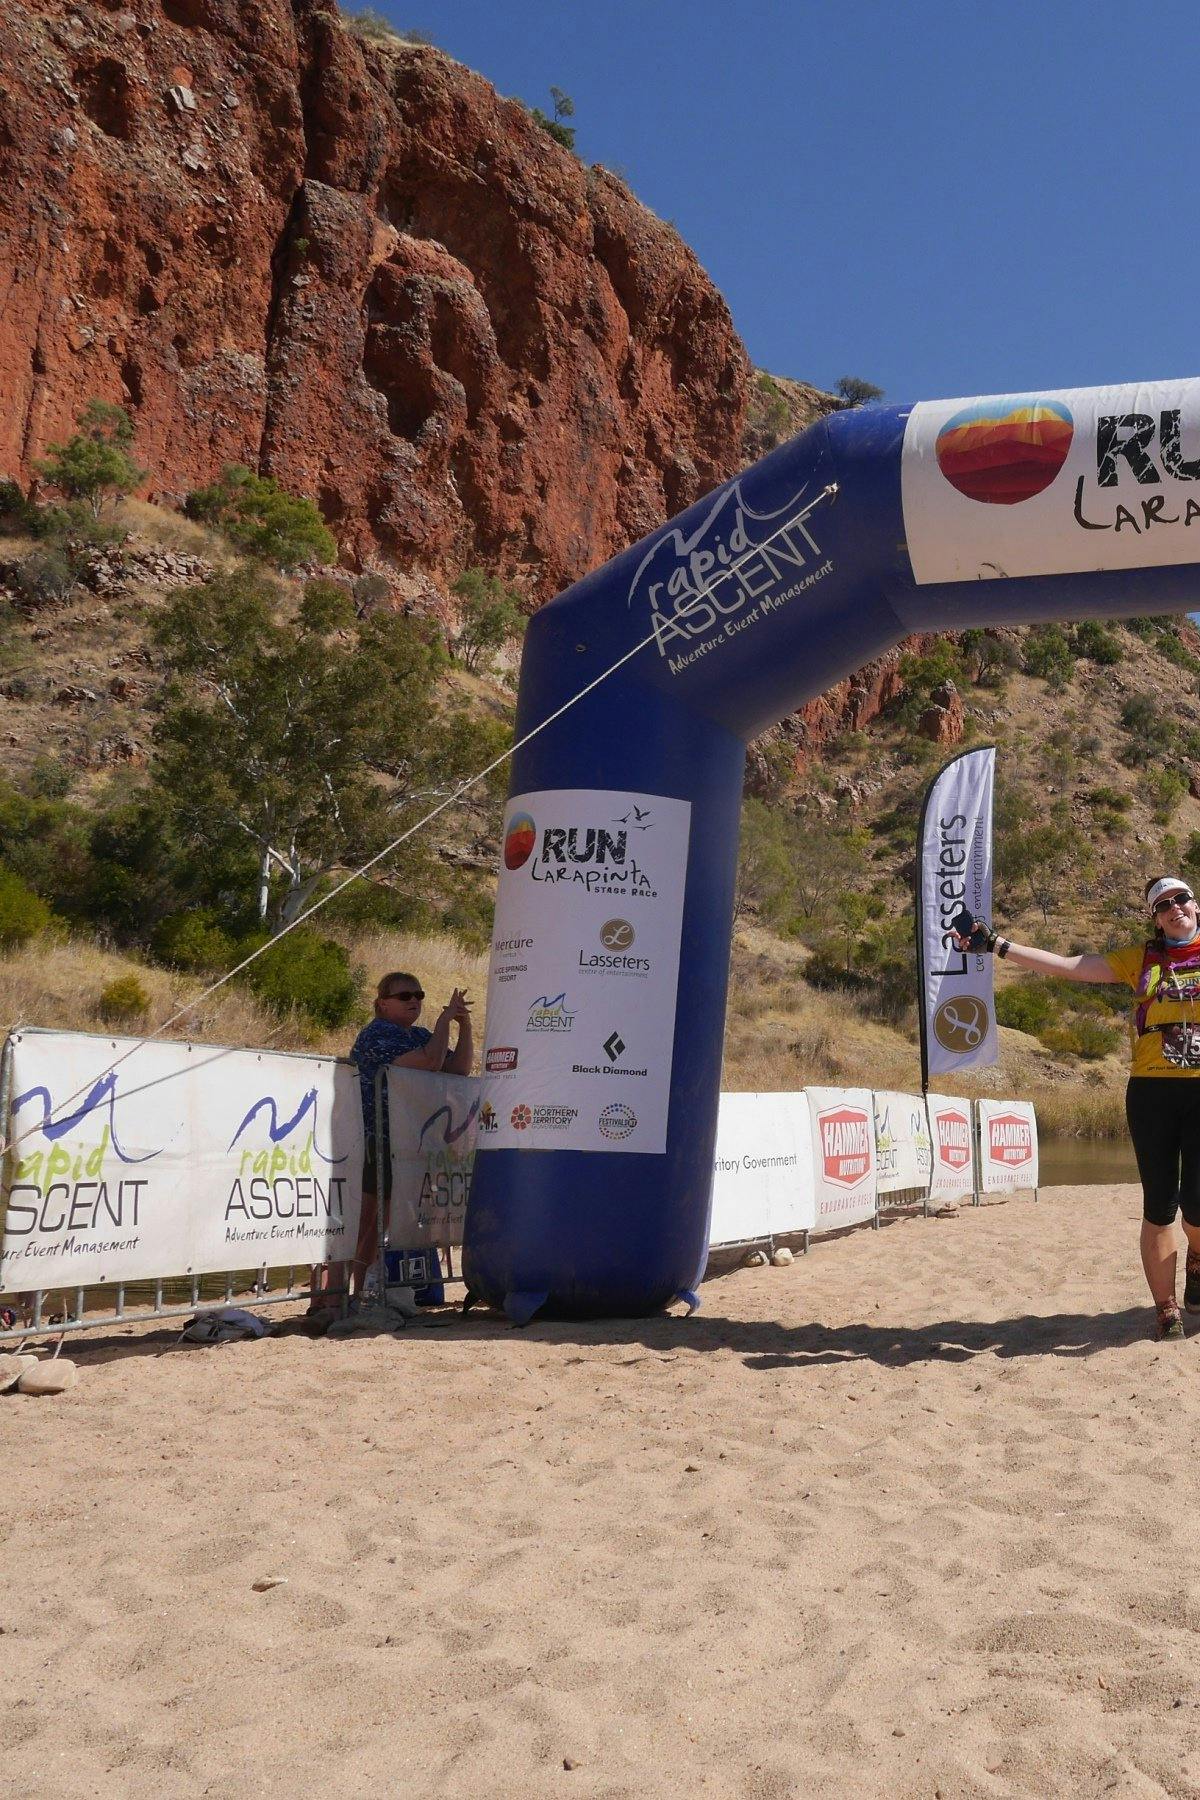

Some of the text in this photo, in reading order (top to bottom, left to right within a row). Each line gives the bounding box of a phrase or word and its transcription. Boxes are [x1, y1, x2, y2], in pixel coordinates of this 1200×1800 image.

[648, 508, 757, 610] rapid
[650, 512, 822, 657] ASCENT
[668, 560, 834, 675] Adventure Event Management
[542, 828, 627, 865] RUN
[970, 815, 984, 910] entertainment
[580, 949, 650, 971] Lasseters
[527, 1016, 575, 1028] ASCENT
[572, 1064, 648, 1077] Black Diamond
[532, 1117, 572, 1125] TERRITORY
[533, 1109, 578, 1117] NORTHERN
[992, 1124, 1030, 1147] HAMMER
[14, 1124, 110, 1197] apid
[240, 1131, 314, 1188] rapid
[743, 1154, 797, 1169] Government
[4, 1179, 148, 1235] SCENT
[225, 1177, 347, 1220] ASCENT
[25, 1241, 61, 1257] Event
[60, 1236, 141, 1257] Management
[225, 1222, 345, 1243] Adventure Event Management
